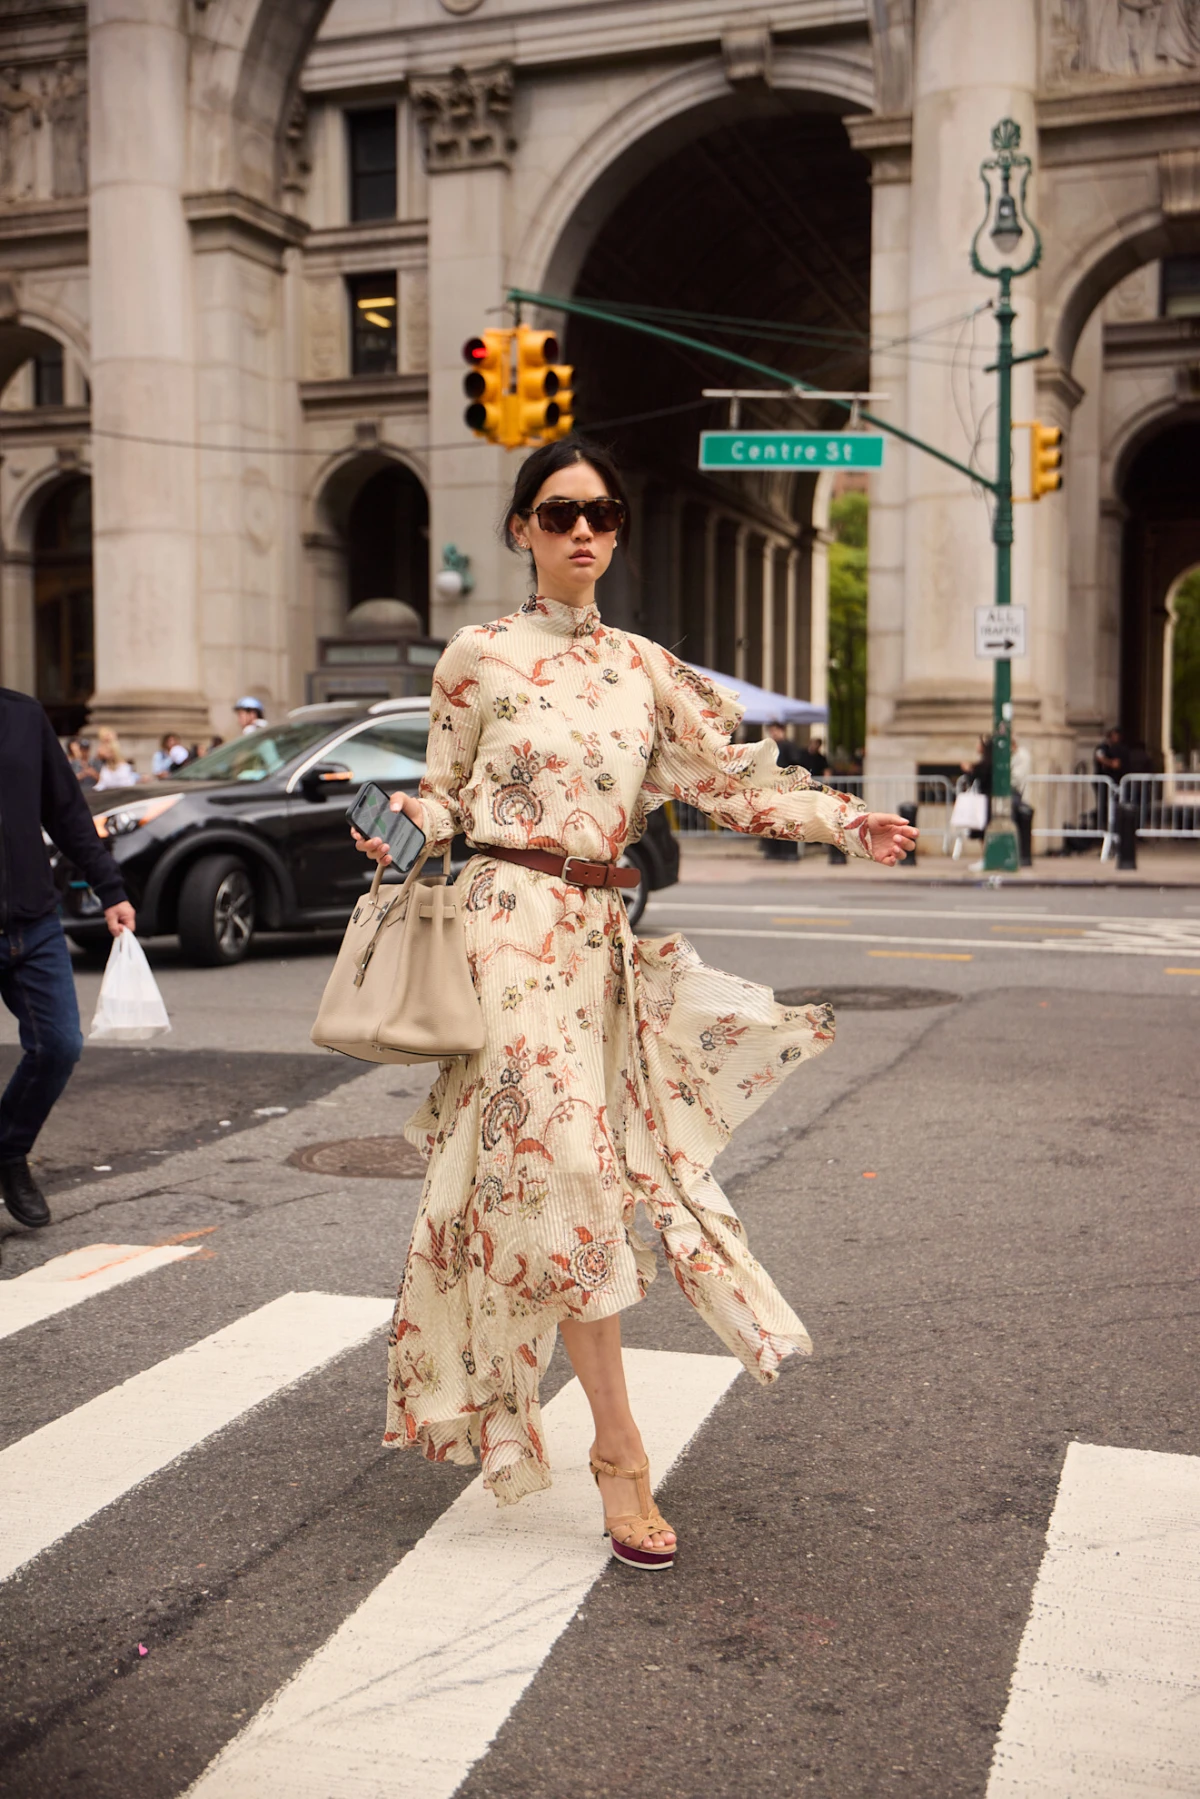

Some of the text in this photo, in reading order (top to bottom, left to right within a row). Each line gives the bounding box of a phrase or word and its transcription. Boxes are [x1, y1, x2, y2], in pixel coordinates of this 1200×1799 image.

[731, 440, 853, 461] Centre St
[986, 609, 1013, 622] ALL
[981, 625, 1020, 636] TRAFFIC
